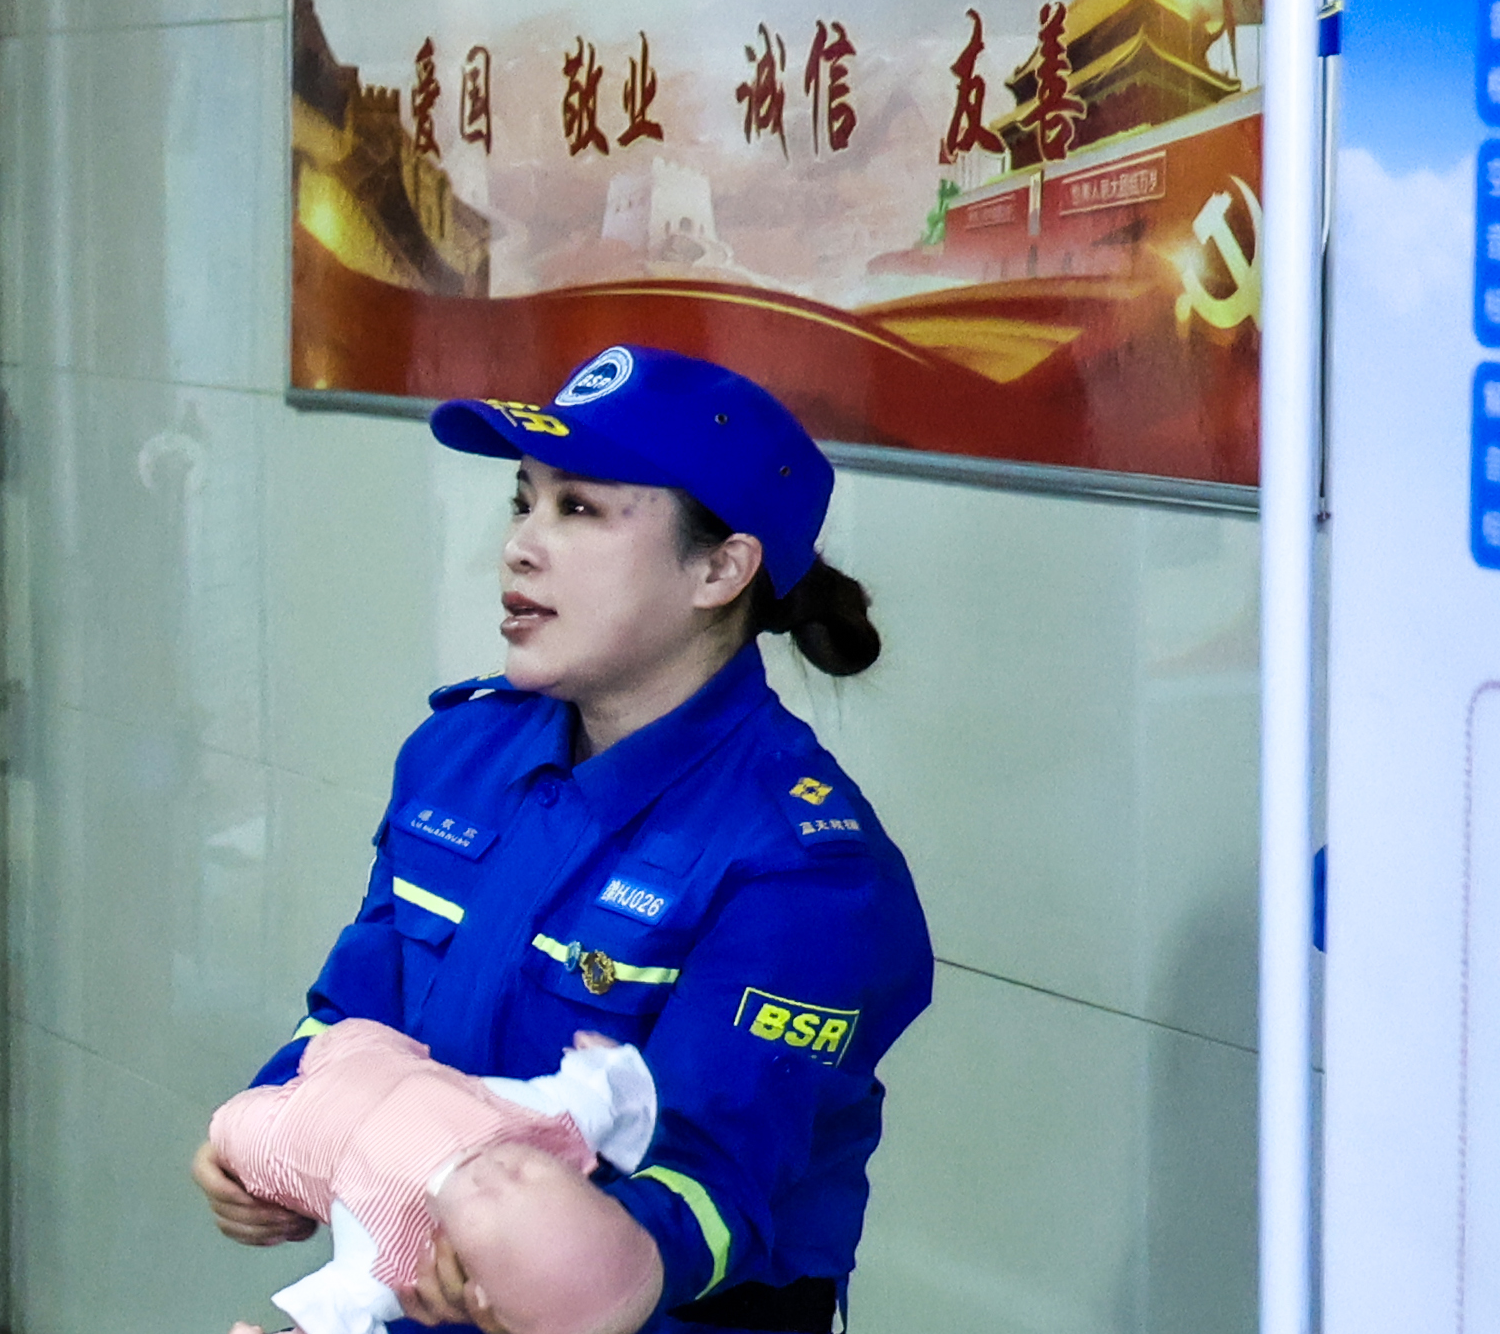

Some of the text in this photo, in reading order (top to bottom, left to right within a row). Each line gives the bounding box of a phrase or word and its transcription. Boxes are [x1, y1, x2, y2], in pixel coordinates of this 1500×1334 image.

[410, 1, 1088, 165] 爱国 敬业 诚信 友善
[749, 1003, 849, 1053] BSR
